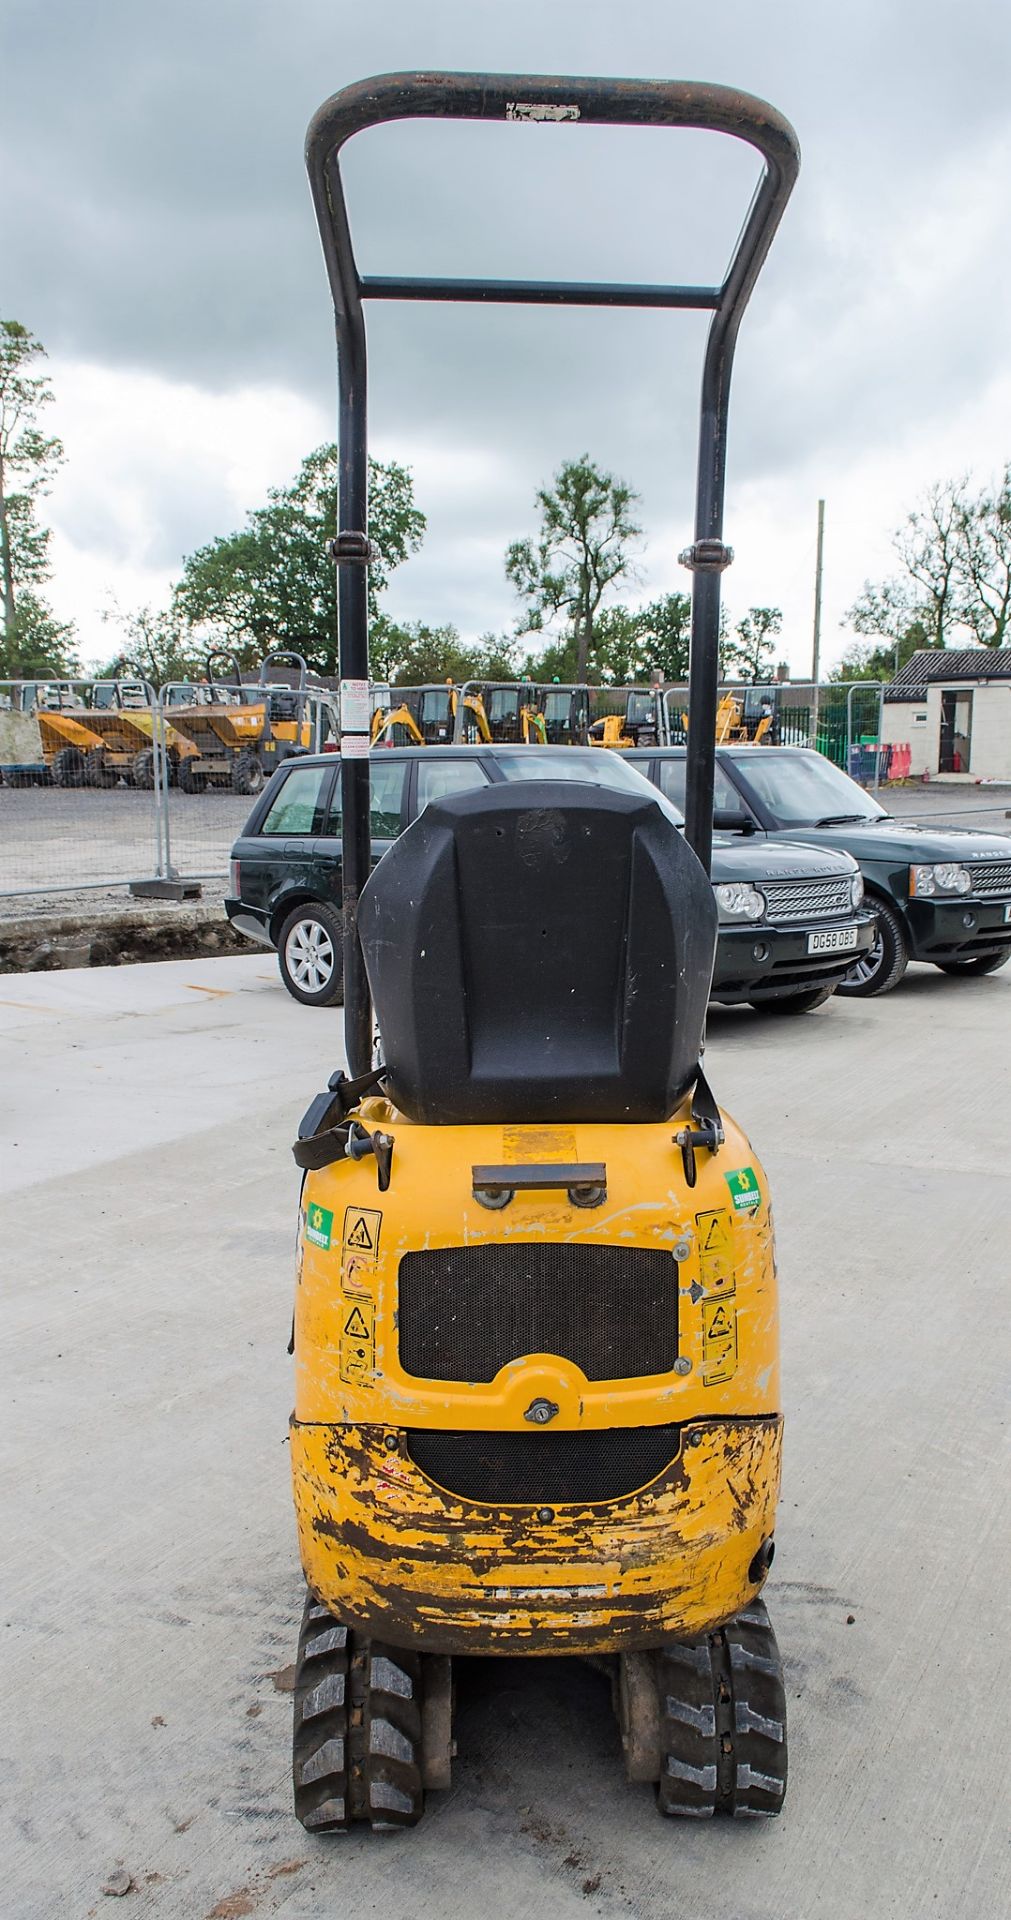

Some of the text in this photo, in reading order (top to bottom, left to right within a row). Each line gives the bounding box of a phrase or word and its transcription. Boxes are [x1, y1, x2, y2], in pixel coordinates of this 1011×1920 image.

[971, 850, 1004, 858] RANGE
[766, 867, 809, 877] RANGE
[813, 933, 837, 949] DG58
